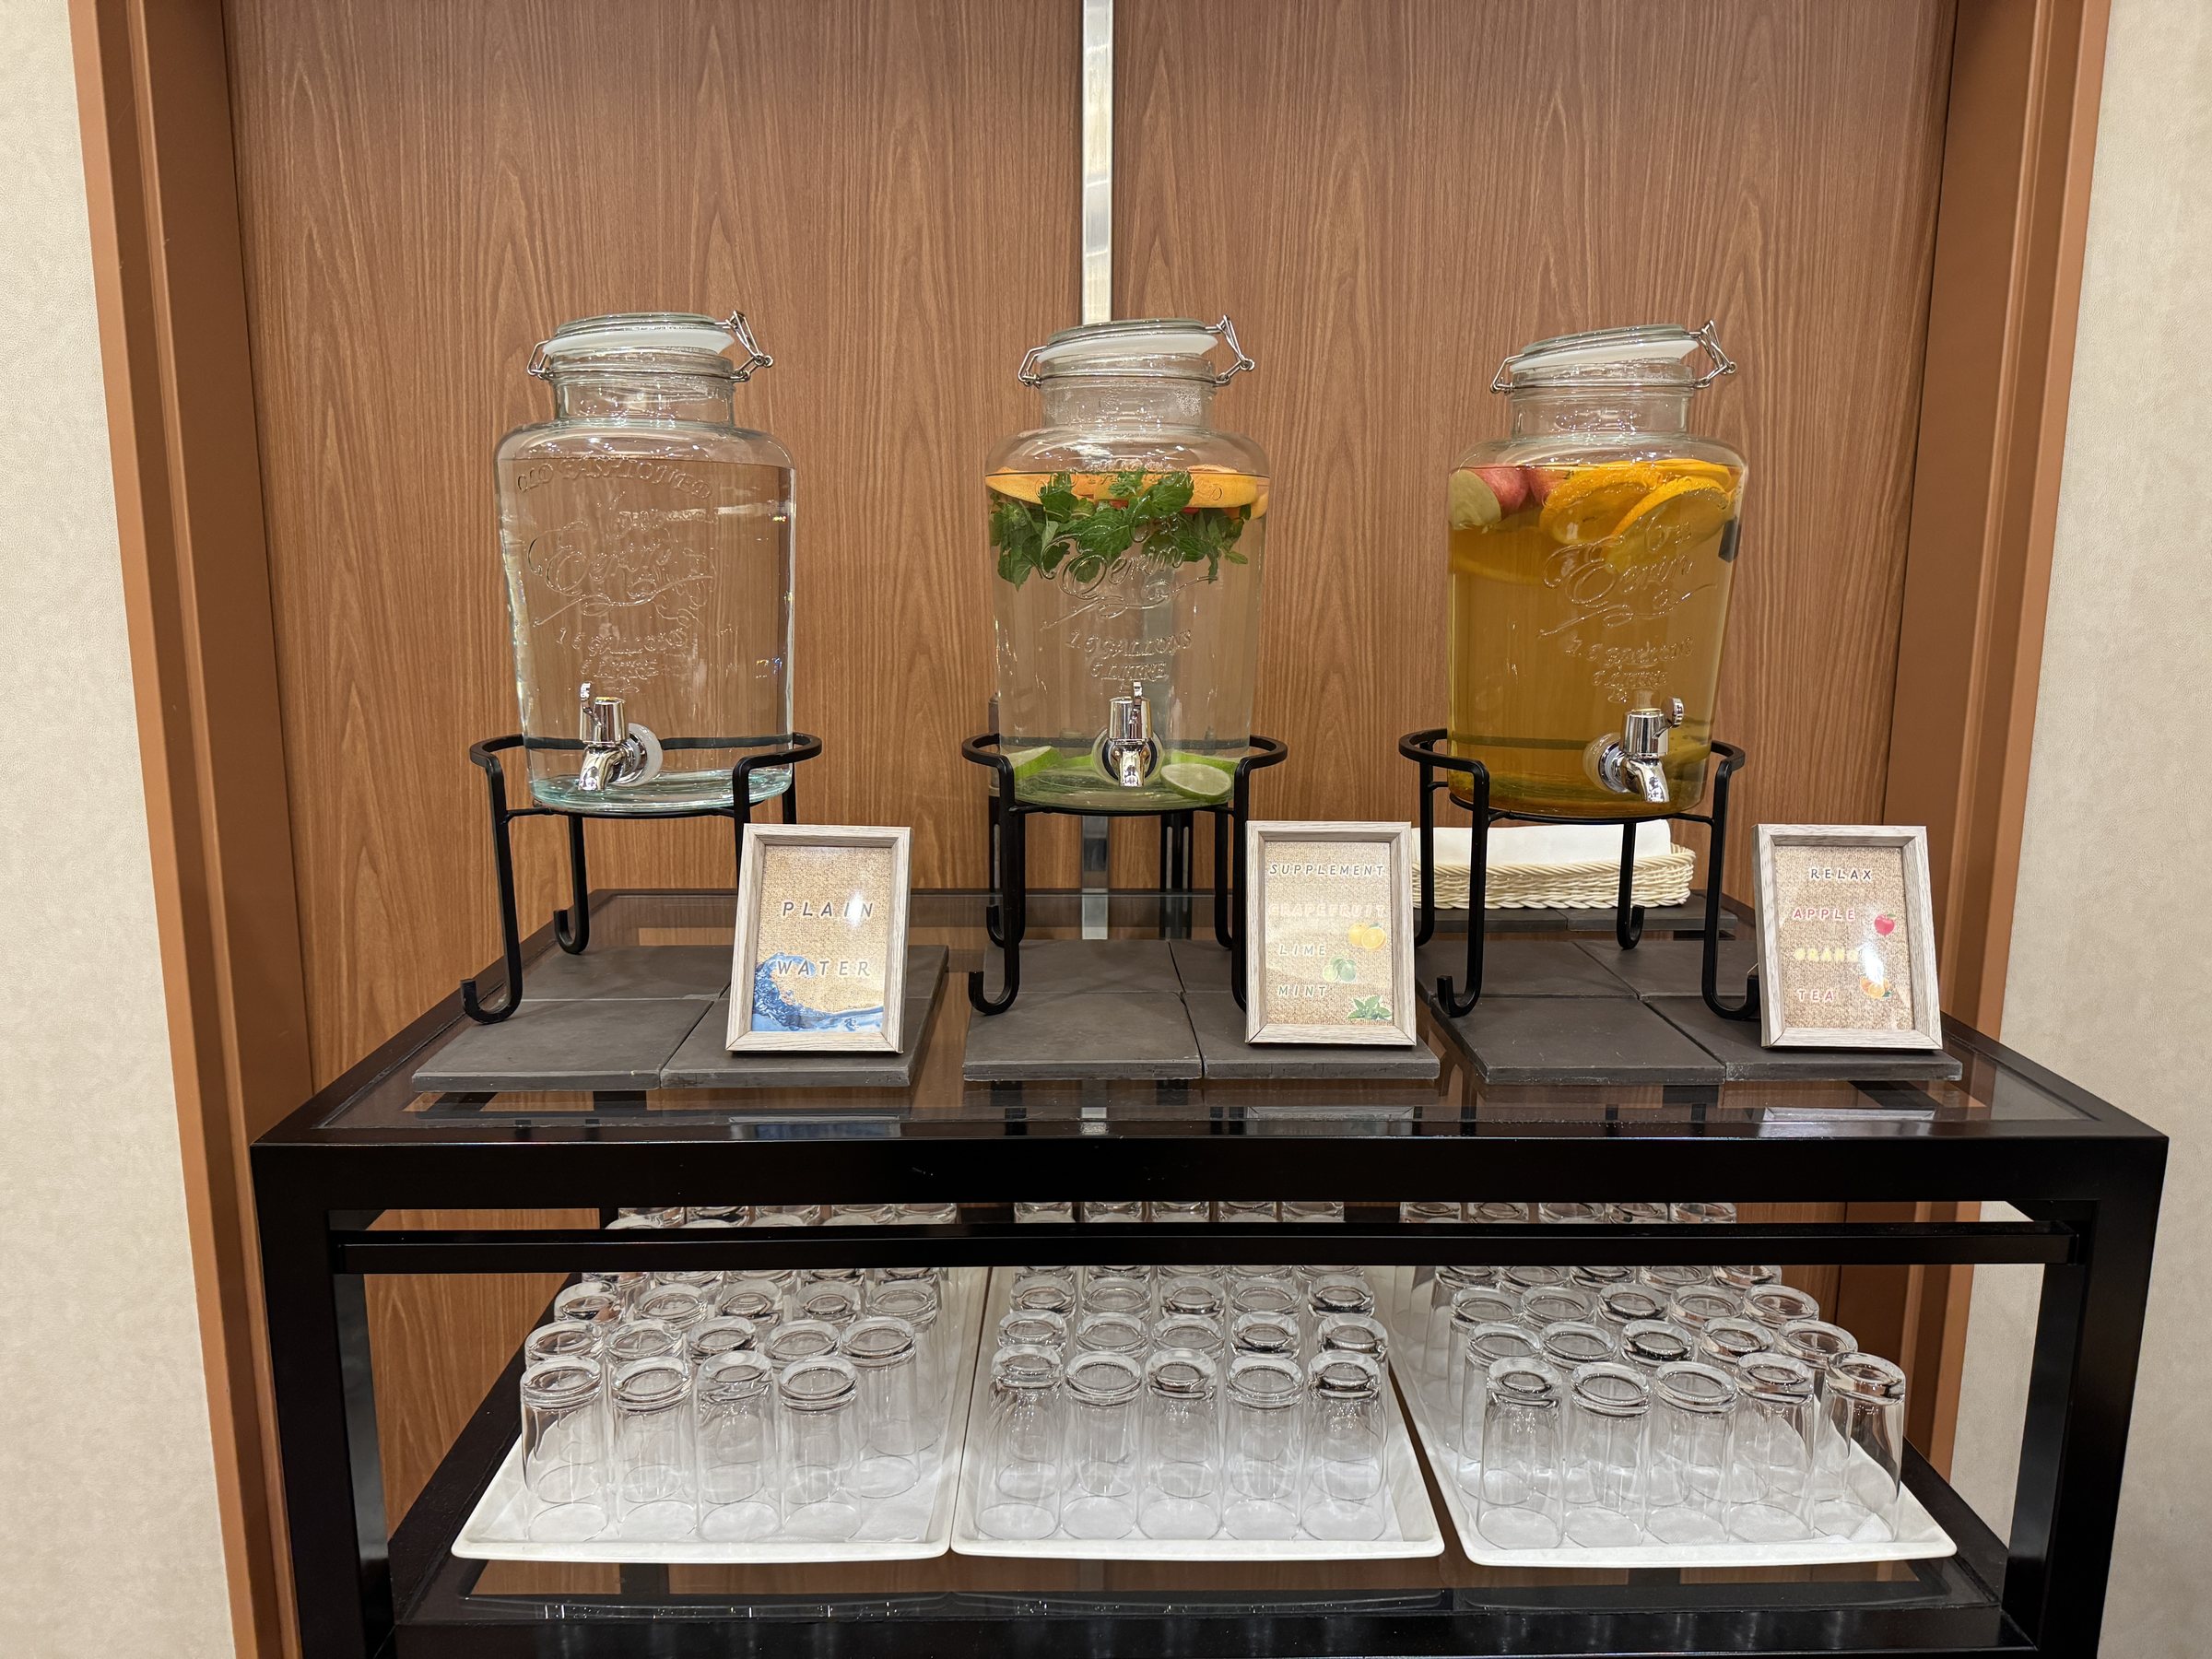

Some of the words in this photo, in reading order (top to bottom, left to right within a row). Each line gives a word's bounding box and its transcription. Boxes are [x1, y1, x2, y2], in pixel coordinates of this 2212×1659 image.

[1268, 863, 1384, 877] SUPPLEMENT
[1810, 867, 1872, 881] RELAX
[782, 900, 874, 919] PLAIN
[1268, 901, 1386, 918] GRAPEFRUIT
[1793, 908, 1855, 921] APPLE
[1278, 944, 1327, 957] LIME
[1793, 947, 1862, 963] ORANG
[776, 959, 871, 978] WATER
[1277, 984, 1327, 997] MINT
[1797, 989, 1834, 1002] TEA
